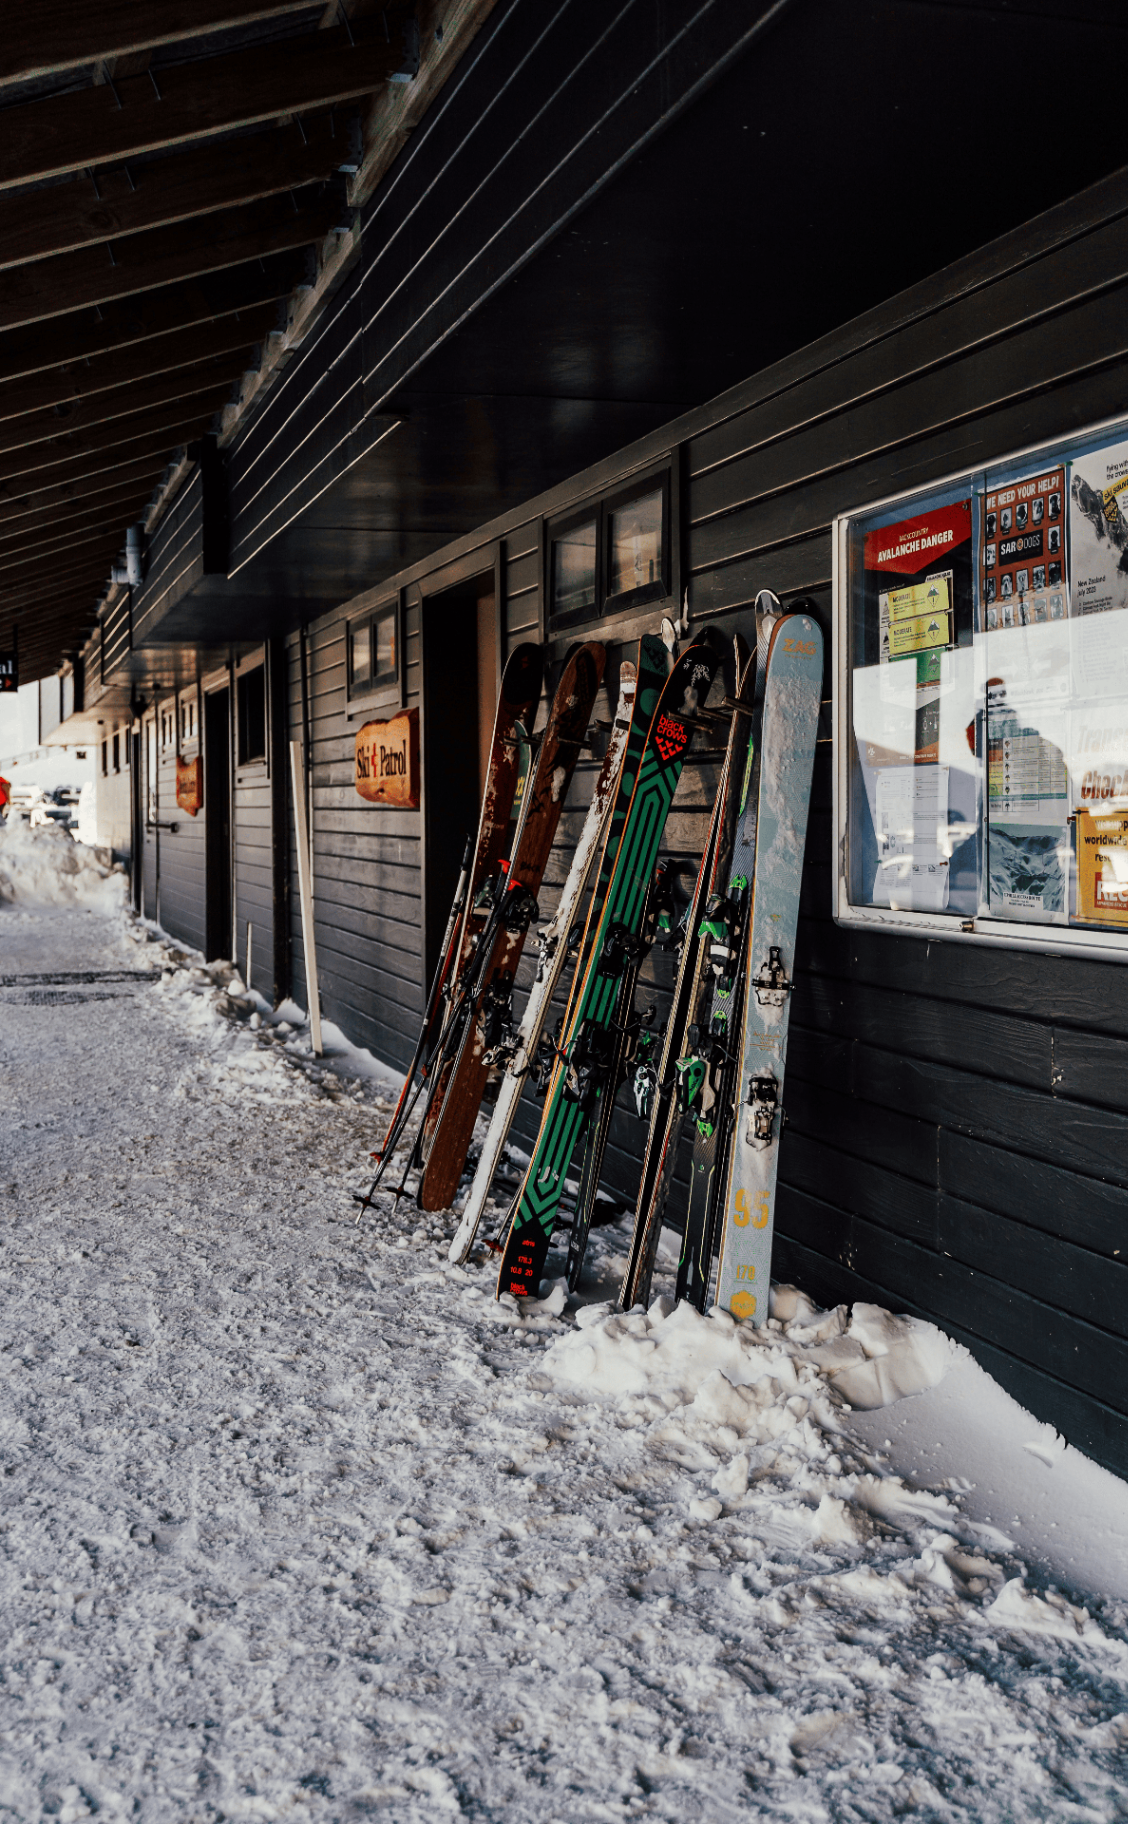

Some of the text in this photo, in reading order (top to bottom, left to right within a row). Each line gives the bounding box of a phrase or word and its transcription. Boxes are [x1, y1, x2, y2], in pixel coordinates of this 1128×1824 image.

[986, 475, 1060, 510] WE NEED YOUR HELP!
[877, 529, 954, 563] AVALANCHE DANGER
[1001, 541, 1016, 555] SAR
[1077, 580, 1088, 588] New
[781, 637, 817, 656] ZAG
[658, 713, 685, 734] black
[656, 724, 688, 744] crows
[357, 739, 407, 779] Ski Patrol
[1084, 834, 1127, 846] worldwide
[733, 1188, 770, 1229] 95
[524, 1268, 534, 1277] 20
[510, 1281, 526, 1291] black
